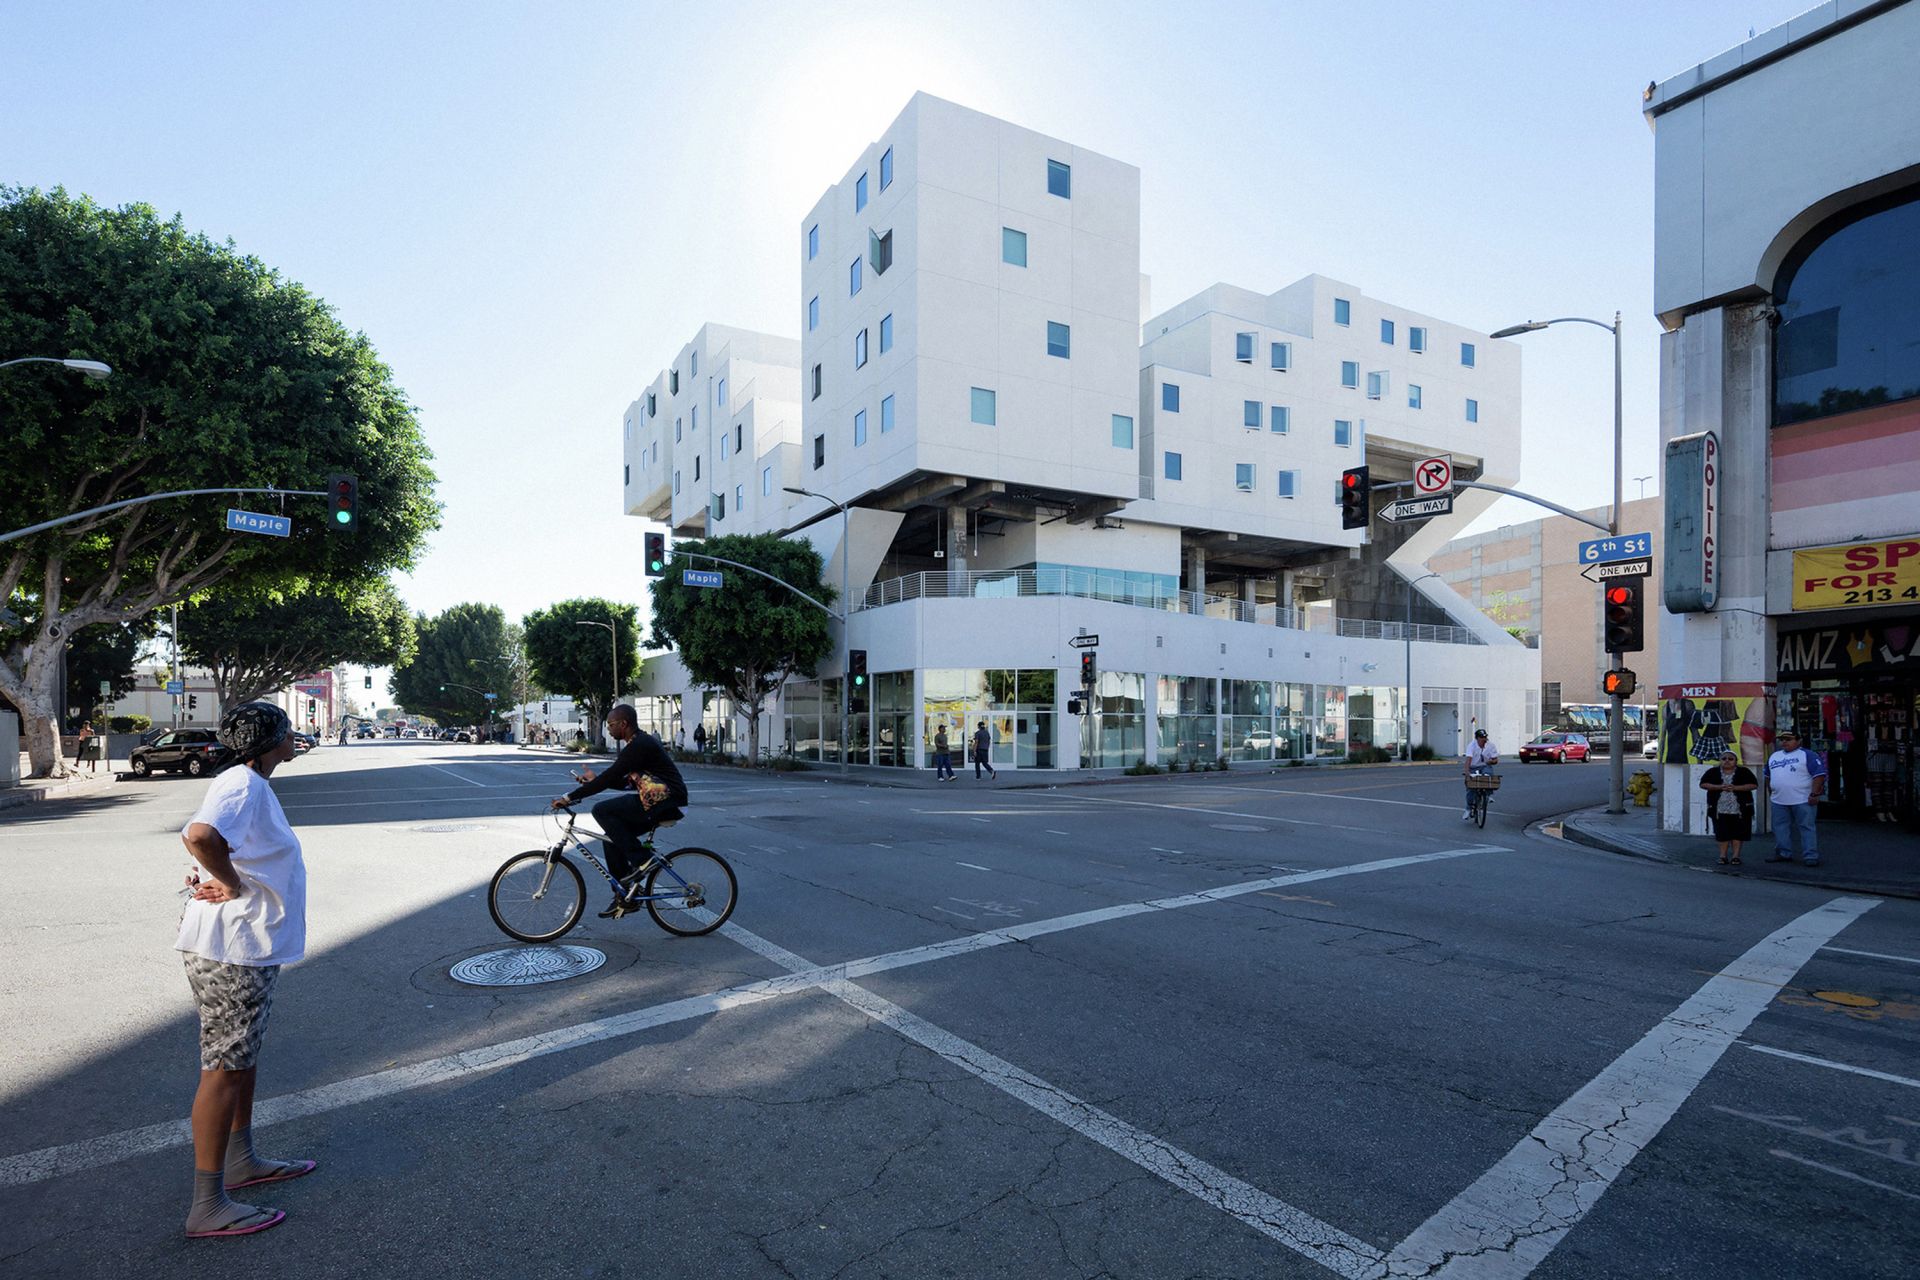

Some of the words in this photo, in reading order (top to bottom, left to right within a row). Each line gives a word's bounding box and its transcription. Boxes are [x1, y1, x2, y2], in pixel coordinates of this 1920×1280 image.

[1395, 504, 1416, 516] ONE
[1423, 500, 1446, 511] WAY
[1703, 439, 1715, 583] POLICE
[235, 514, 284, 530] Maple
[1585, 541, 1617, 560] 6th
[1624, 538, 1646, 554] St
[1844, 541, 1920, 571] SP
[1600, 566, 1620, 576] ONE
[1623, 564, 1645, 573] WAY
[688, 573, 719, 584] Maple
[1805, 572, 1898, 592] FOR
[1844, 588, 1893, 604] 213
[1776, 630, 1839, 672] AMZ
[1682, 686, 1717, 697] MEN
